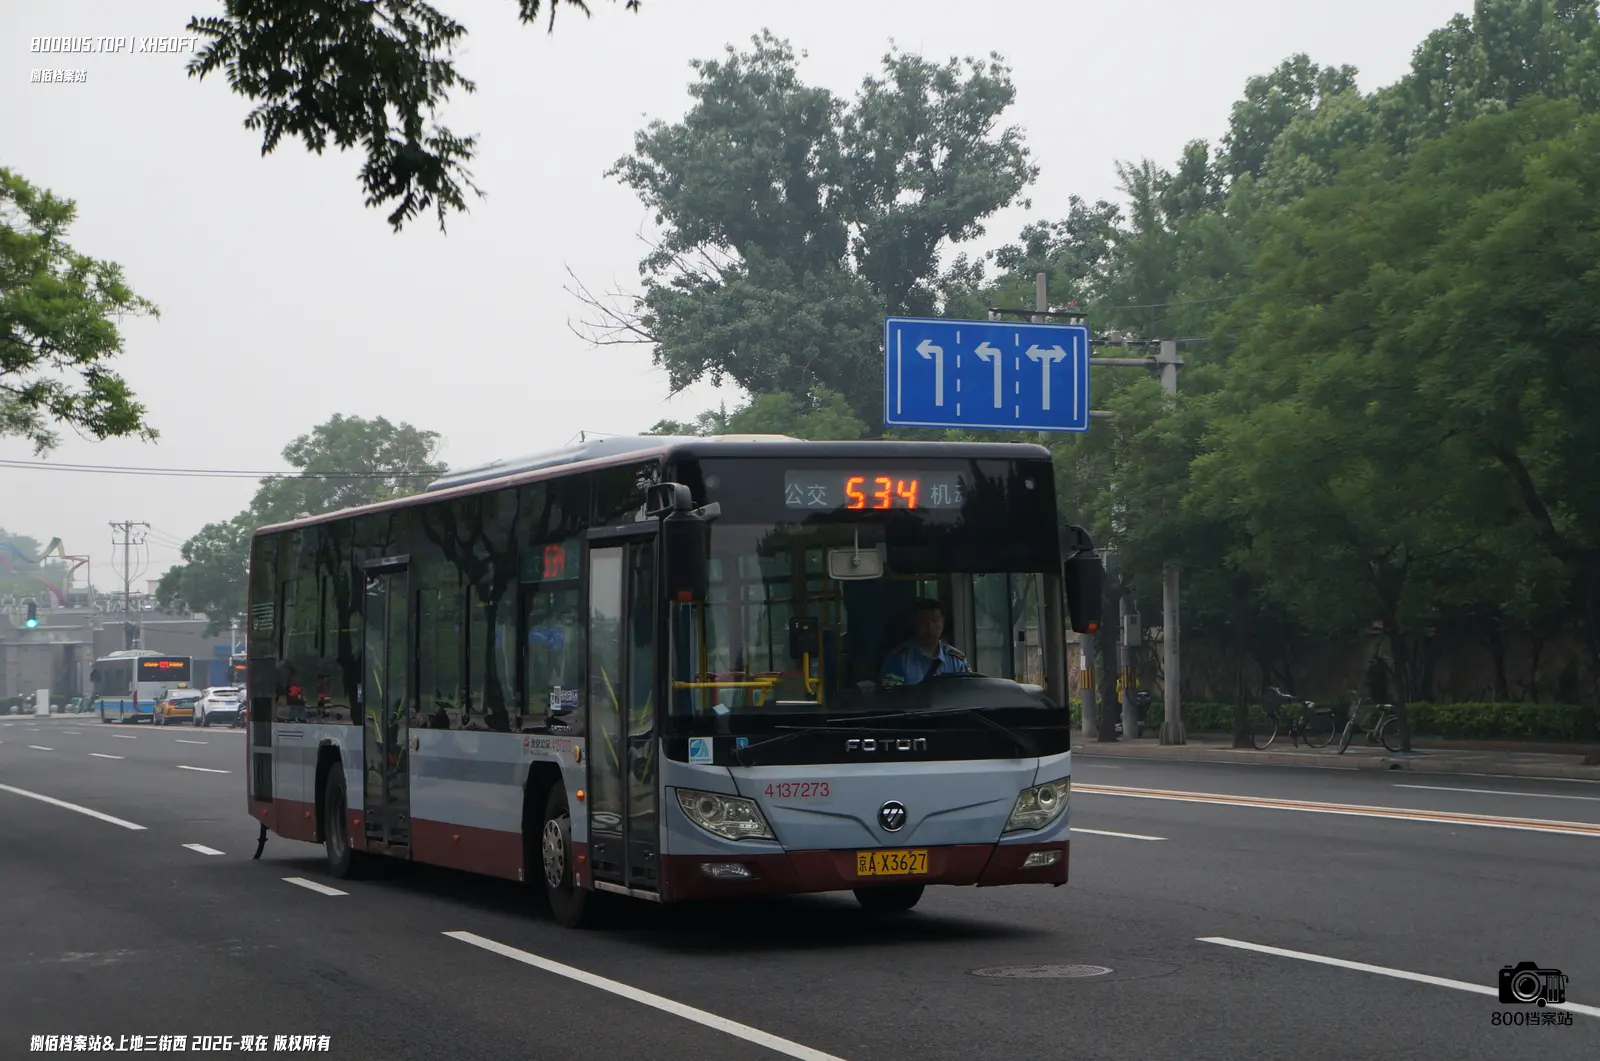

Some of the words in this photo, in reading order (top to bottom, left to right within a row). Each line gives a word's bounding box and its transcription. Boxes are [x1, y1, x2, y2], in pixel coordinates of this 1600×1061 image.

[785, 483, 828, 506] 公交
[846, 476, 918, 510] 534
[845, 737, 928, 752] FOTON
[764, 782, 830, 798] 4137273
